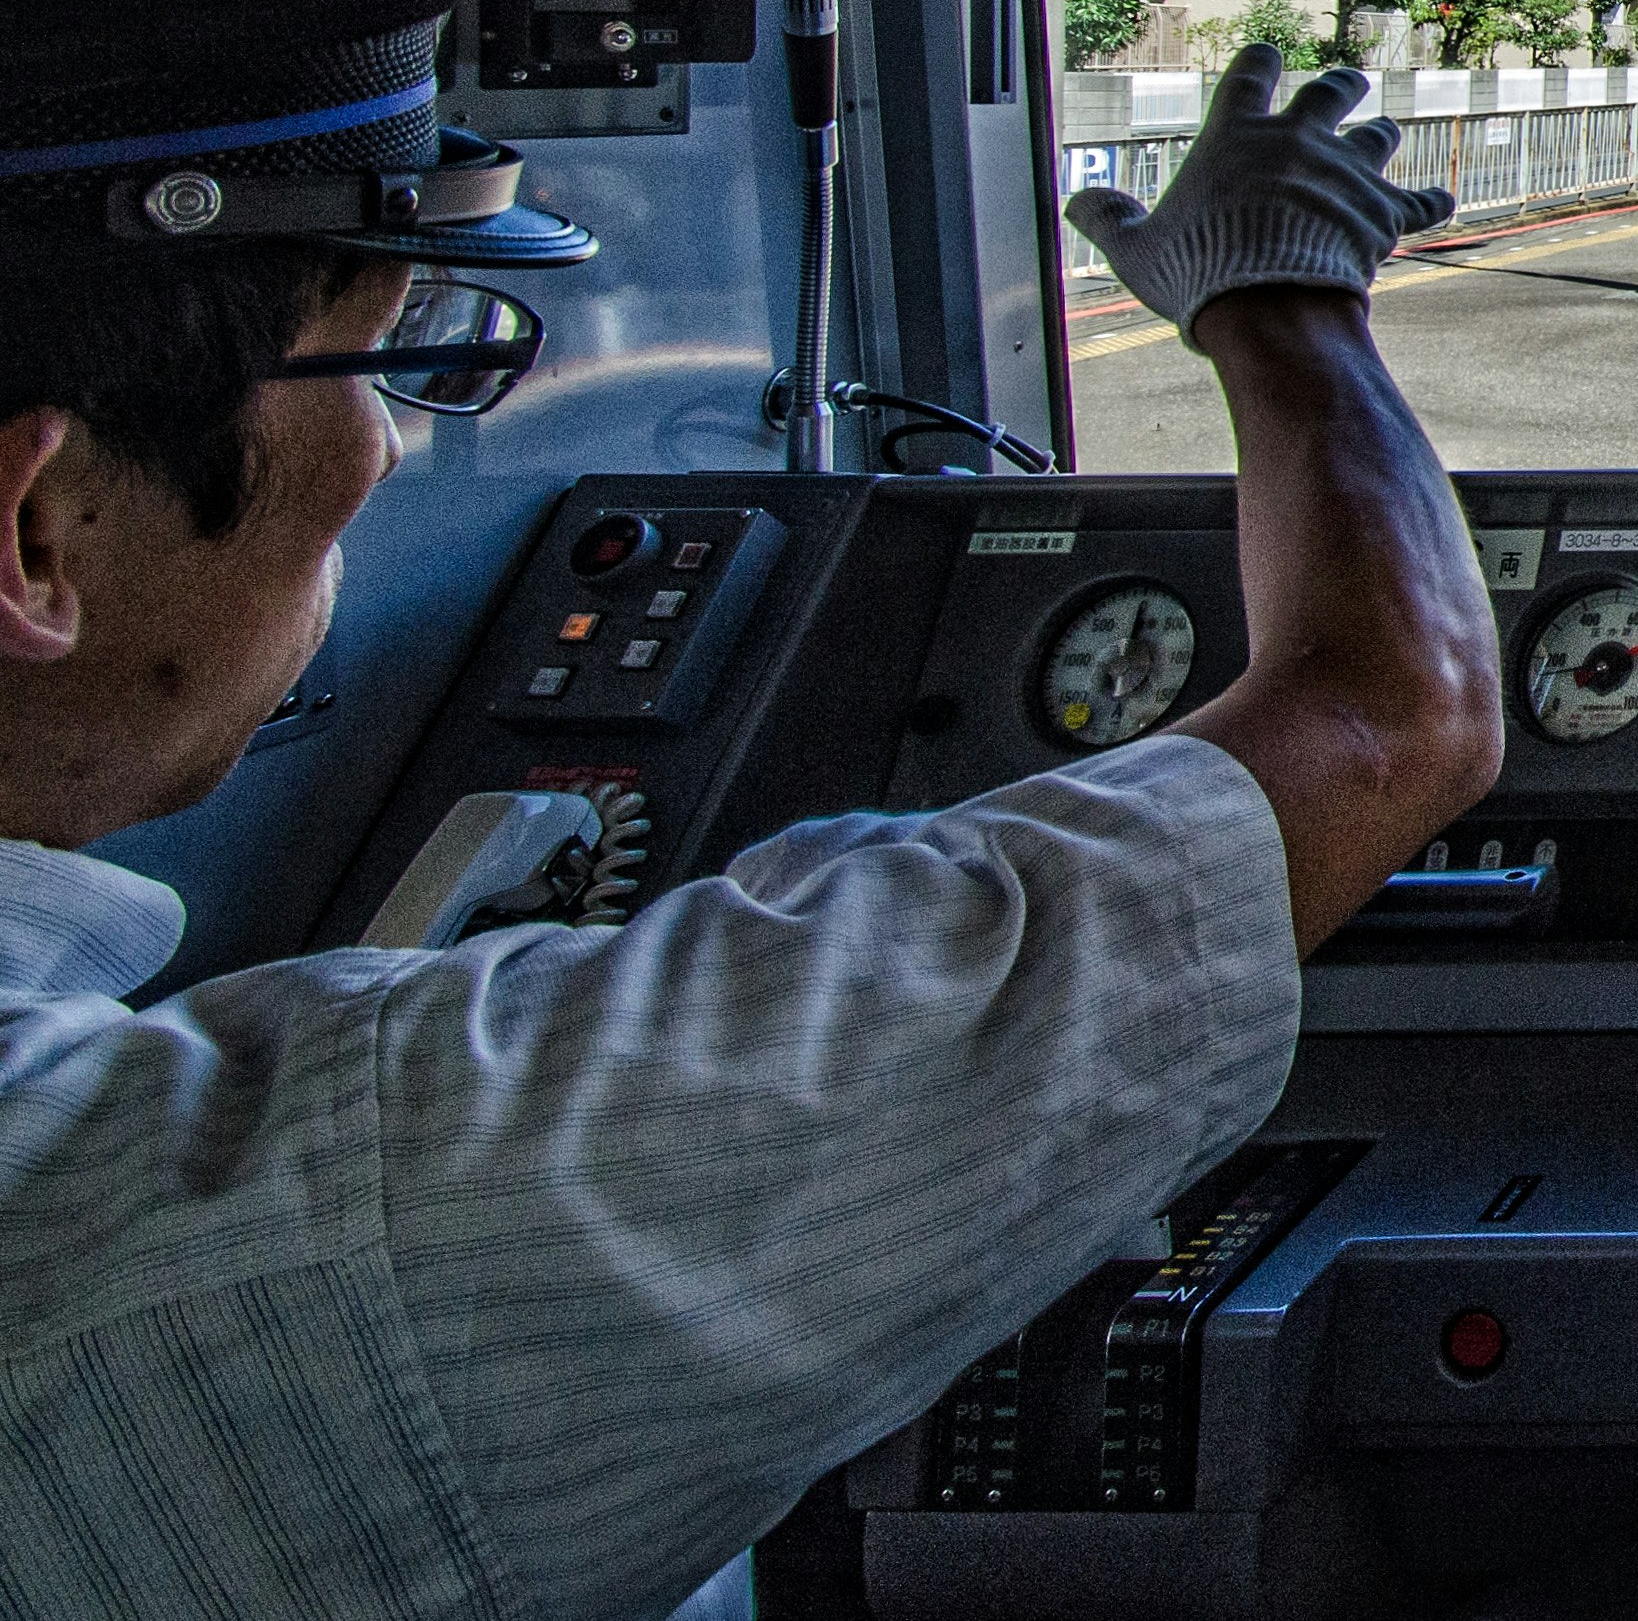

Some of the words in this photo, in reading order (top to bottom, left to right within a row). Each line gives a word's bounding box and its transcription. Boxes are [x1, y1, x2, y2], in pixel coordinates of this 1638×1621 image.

[1070, 148, 1109, 193] P
[1092, 618, 1115, 632] 500
[1580, 613, 1600, 626] 400
[1063, 653, 1091, 666] 1000
[1552, 698, 1560, 711] 0
[1168, 1285, 1197, 1303] N
[1142, 1318, 1170, 1338] P1
[1139, 1365, 1167, 1382] P2
[956, 1404, 983, 1422] P3
[1138, 1404, 1165, 1421] P3
[954, 1436, 980, 1453] P4
[1137, 1436, 1163, 1452] P4
